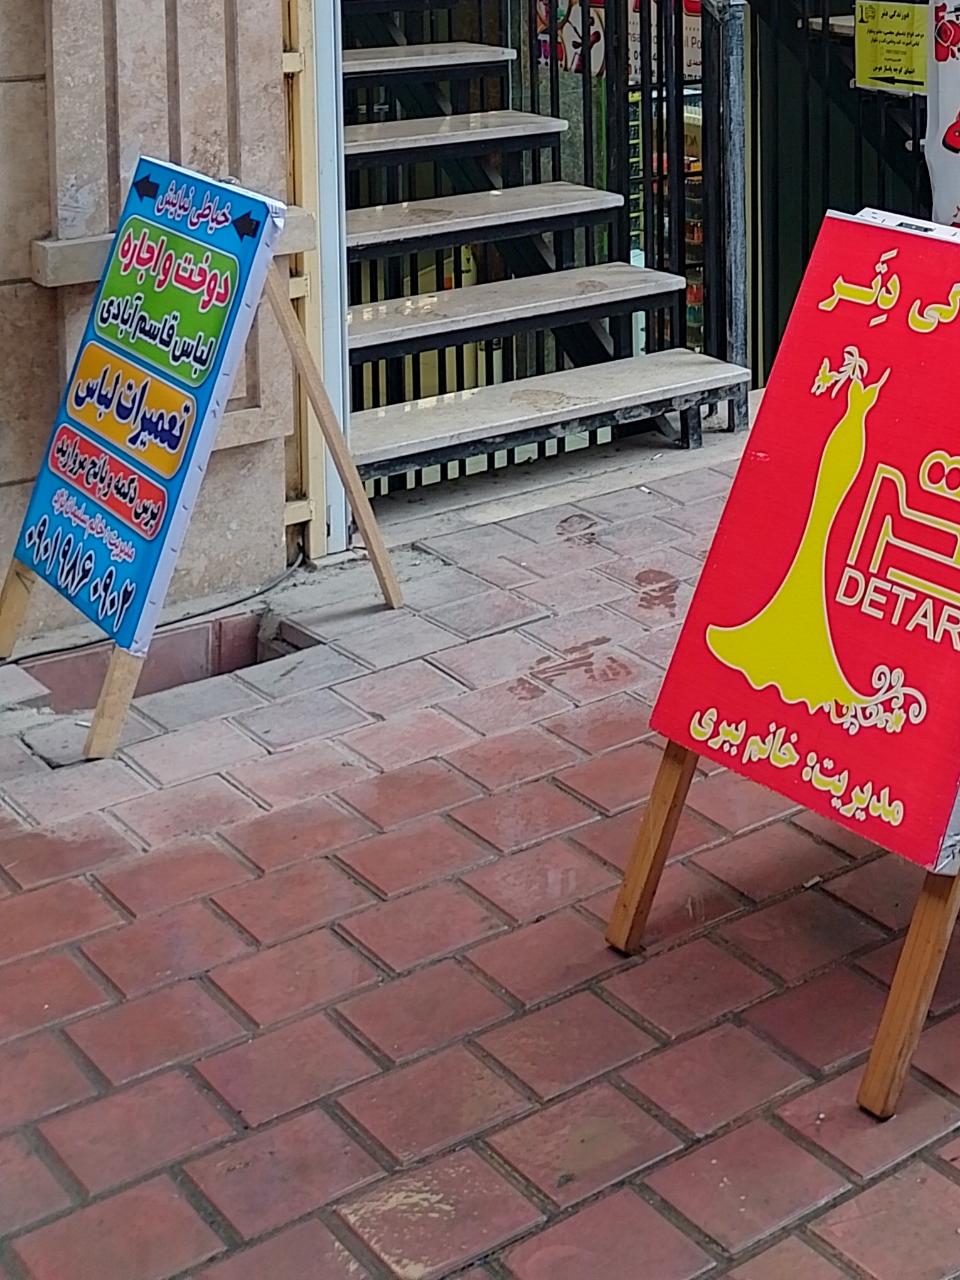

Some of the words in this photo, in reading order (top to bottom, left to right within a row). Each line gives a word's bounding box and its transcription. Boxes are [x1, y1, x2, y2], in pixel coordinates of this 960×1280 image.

[155, 180, 195, 221] نیایش
[187, 190, 232, 234] خیاطی
[118, 228, 167, 284] اجاره
[154, 249, 175, 292] و
[172, 251, 231, 312] دوخت
[98, 293, 145, 338] آبادی
[129, 311, 180, 350] قاسم
[169, 333, 216, 378] لباس
[73, 364, 122, 421] لباس
[115, 377, 192, 452] تعمیرات
[741, 722, 800, 768] خانم
[801, 752, 904, 826] مدیریت:
